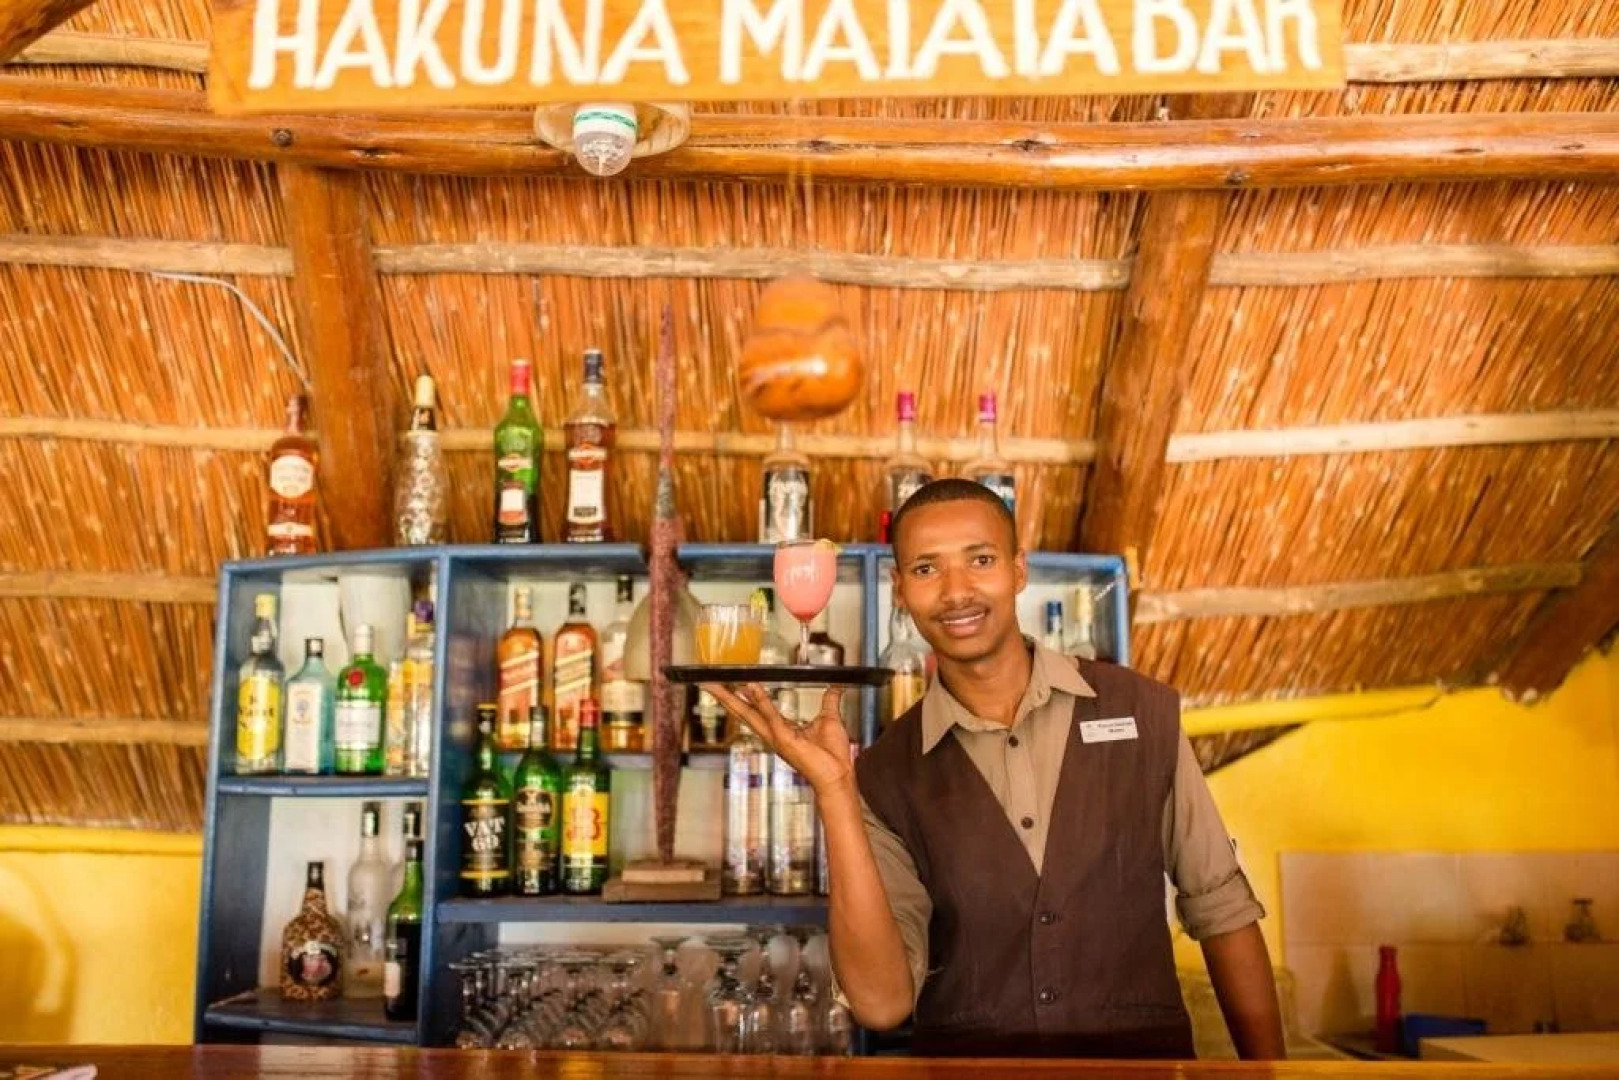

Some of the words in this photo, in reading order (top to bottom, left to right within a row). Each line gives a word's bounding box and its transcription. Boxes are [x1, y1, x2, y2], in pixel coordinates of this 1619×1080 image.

[248, 0, 690, 89] HAKUNA
[1131, 0, 1323, 75] BAR
[464, 816, 504, 837] VAT
